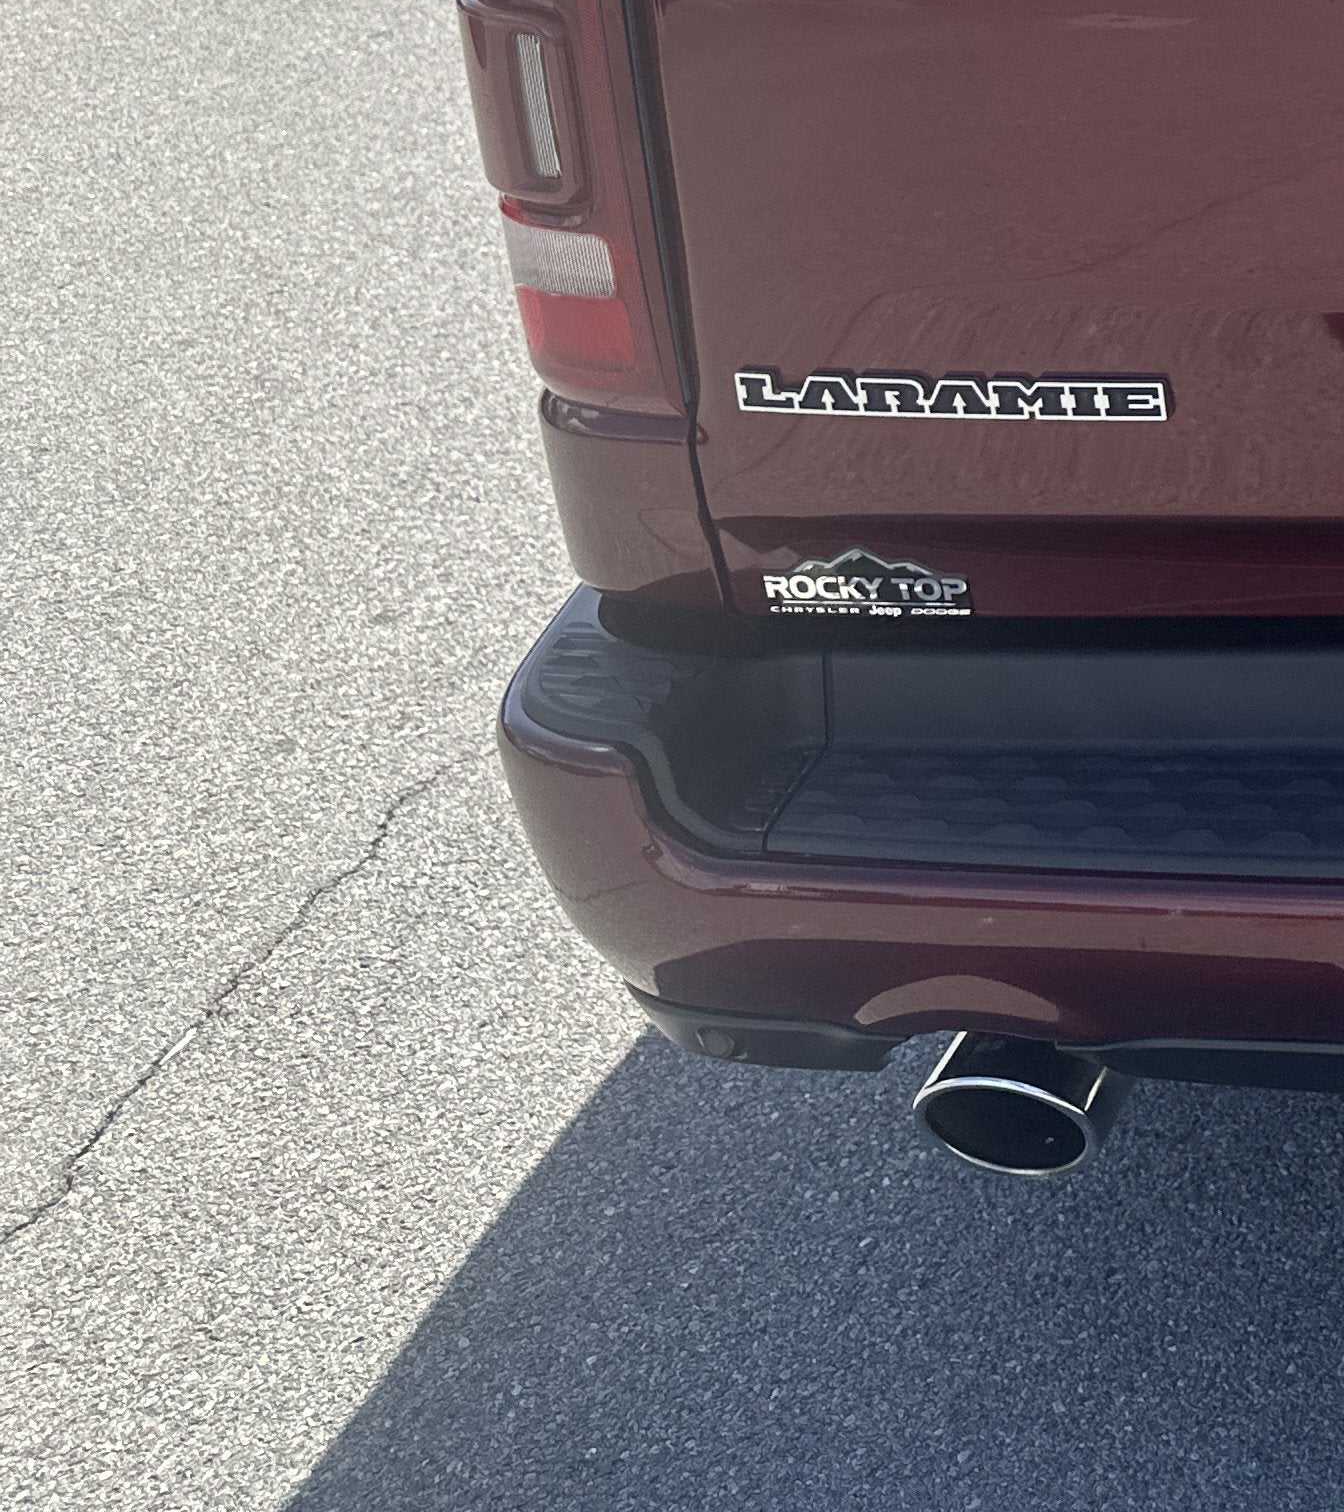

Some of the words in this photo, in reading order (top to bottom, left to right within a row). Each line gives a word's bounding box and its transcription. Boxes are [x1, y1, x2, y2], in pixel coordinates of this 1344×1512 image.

[733, 372, 1168, 422] LARAMIE
[762, 575, 883, 601] ROCKY
[889, 576, 968, 601] TOP
[769, 604, 861, 615] CHRYSLER
[867, 603, 903, 617] Jeep
[910, 607, 972, 616] DODGE
